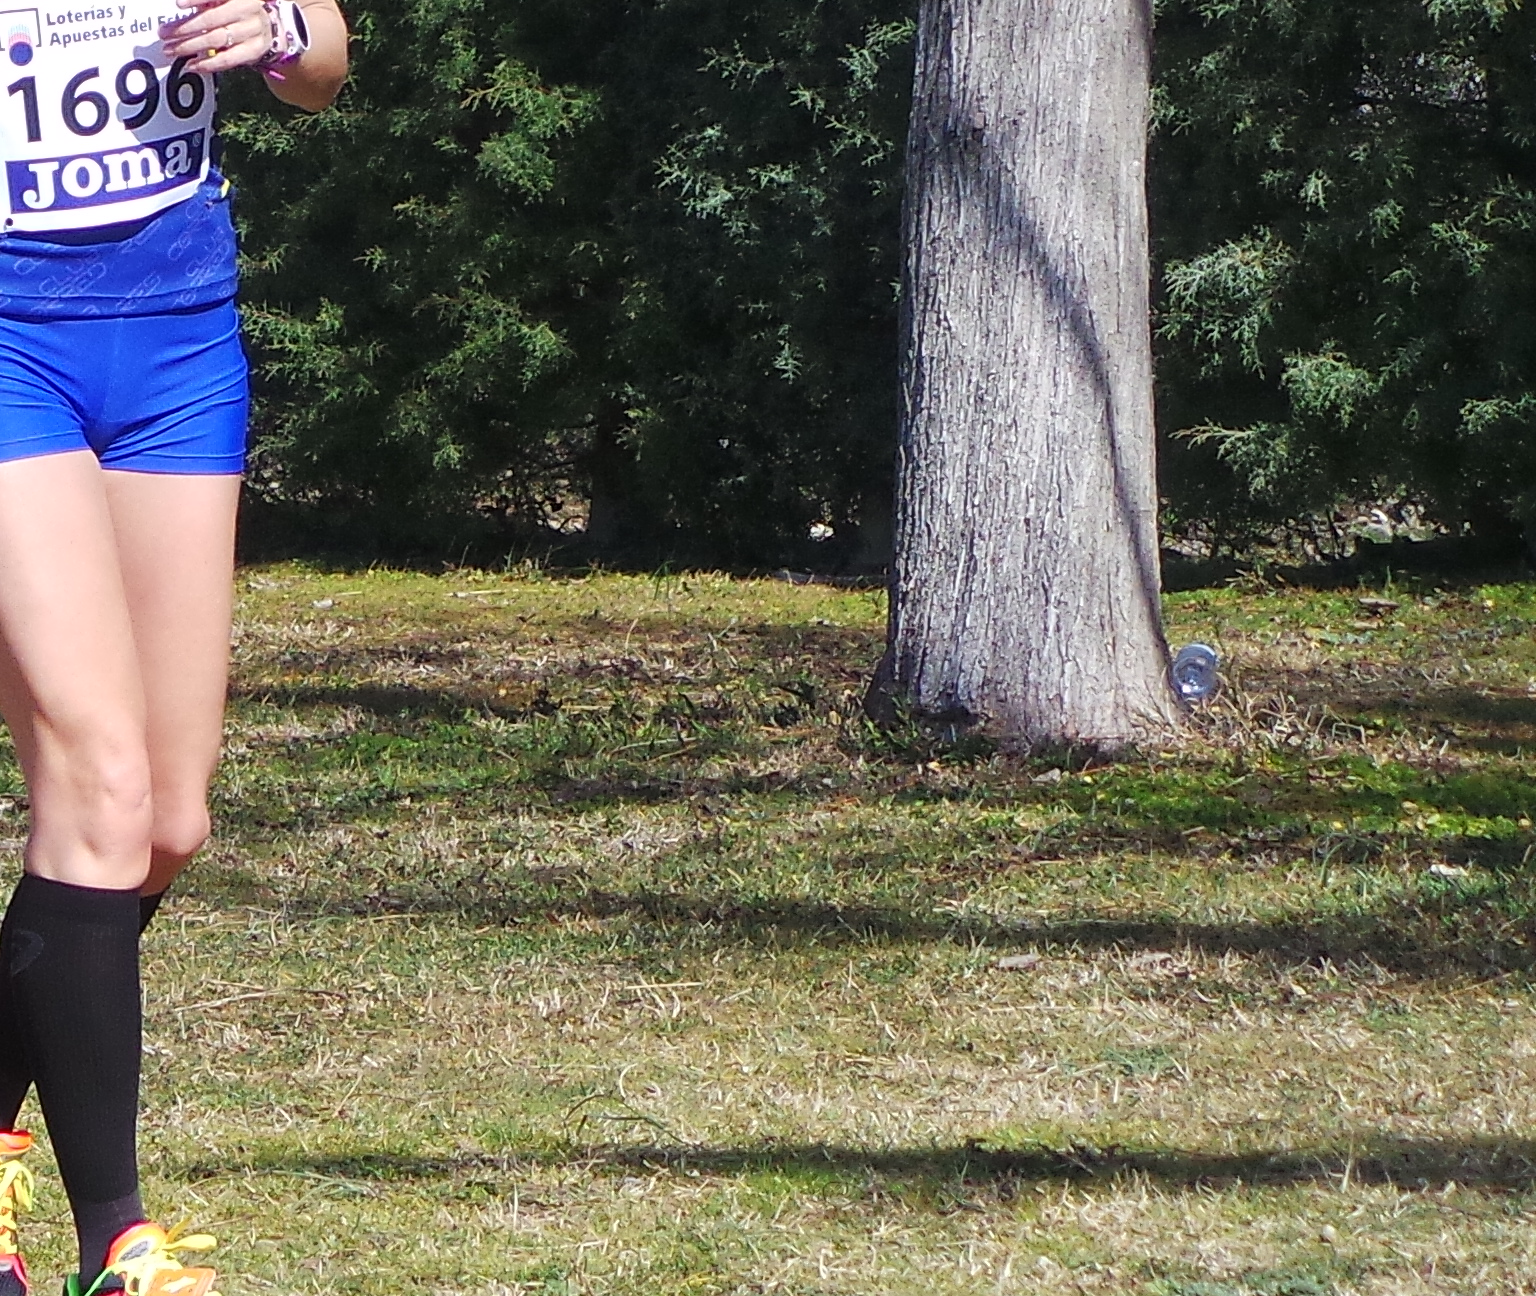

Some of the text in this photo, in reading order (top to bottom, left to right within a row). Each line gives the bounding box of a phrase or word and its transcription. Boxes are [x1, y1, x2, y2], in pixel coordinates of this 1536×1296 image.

[49, 23, 125, 48] Apuestas
[130, 16, 153, 34] del
[117, 4, 127, 22] y
[7, 56, 205, 143] 1696
[22, 140, 192, 210] Joma
